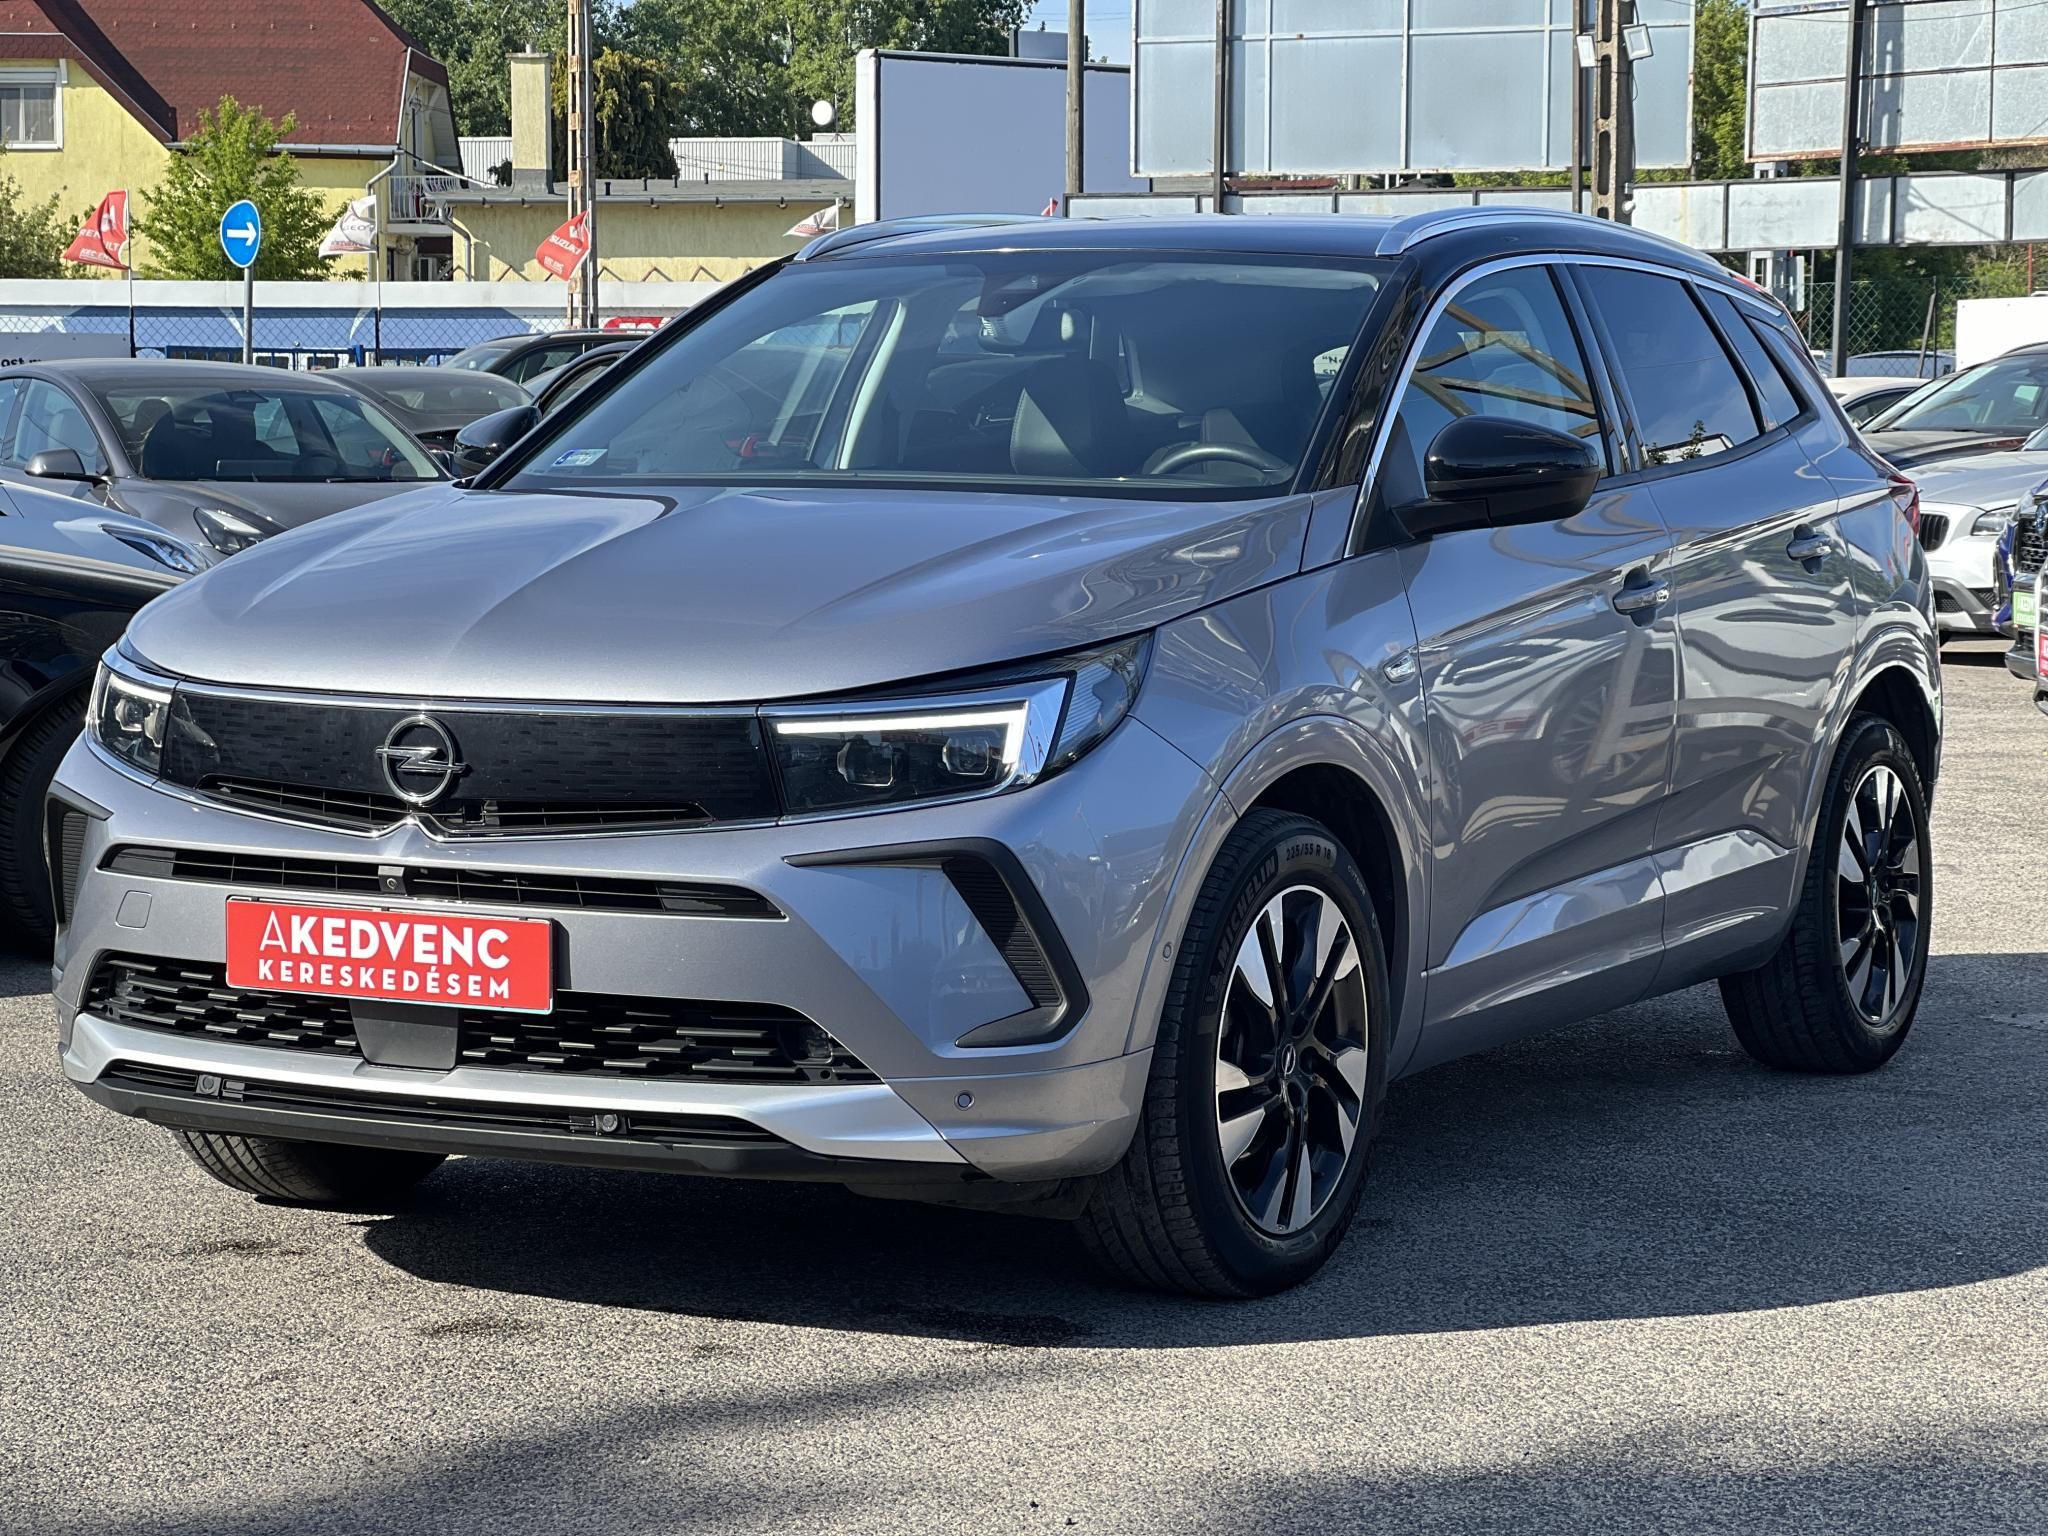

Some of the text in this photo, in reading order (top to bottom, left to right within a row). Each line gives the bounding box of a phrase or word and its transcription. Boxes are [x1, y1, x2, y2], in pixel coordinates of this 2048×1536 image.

[549, 234, 582, 255] SUZUKI
[1286, 843, 1314, 861] 225/55
[1324, 847, 1332, 860] 18
[1217, 856, 1277, 969] MICHELIN
[259, 958, 510, 999] KERESKEDÉSEM
